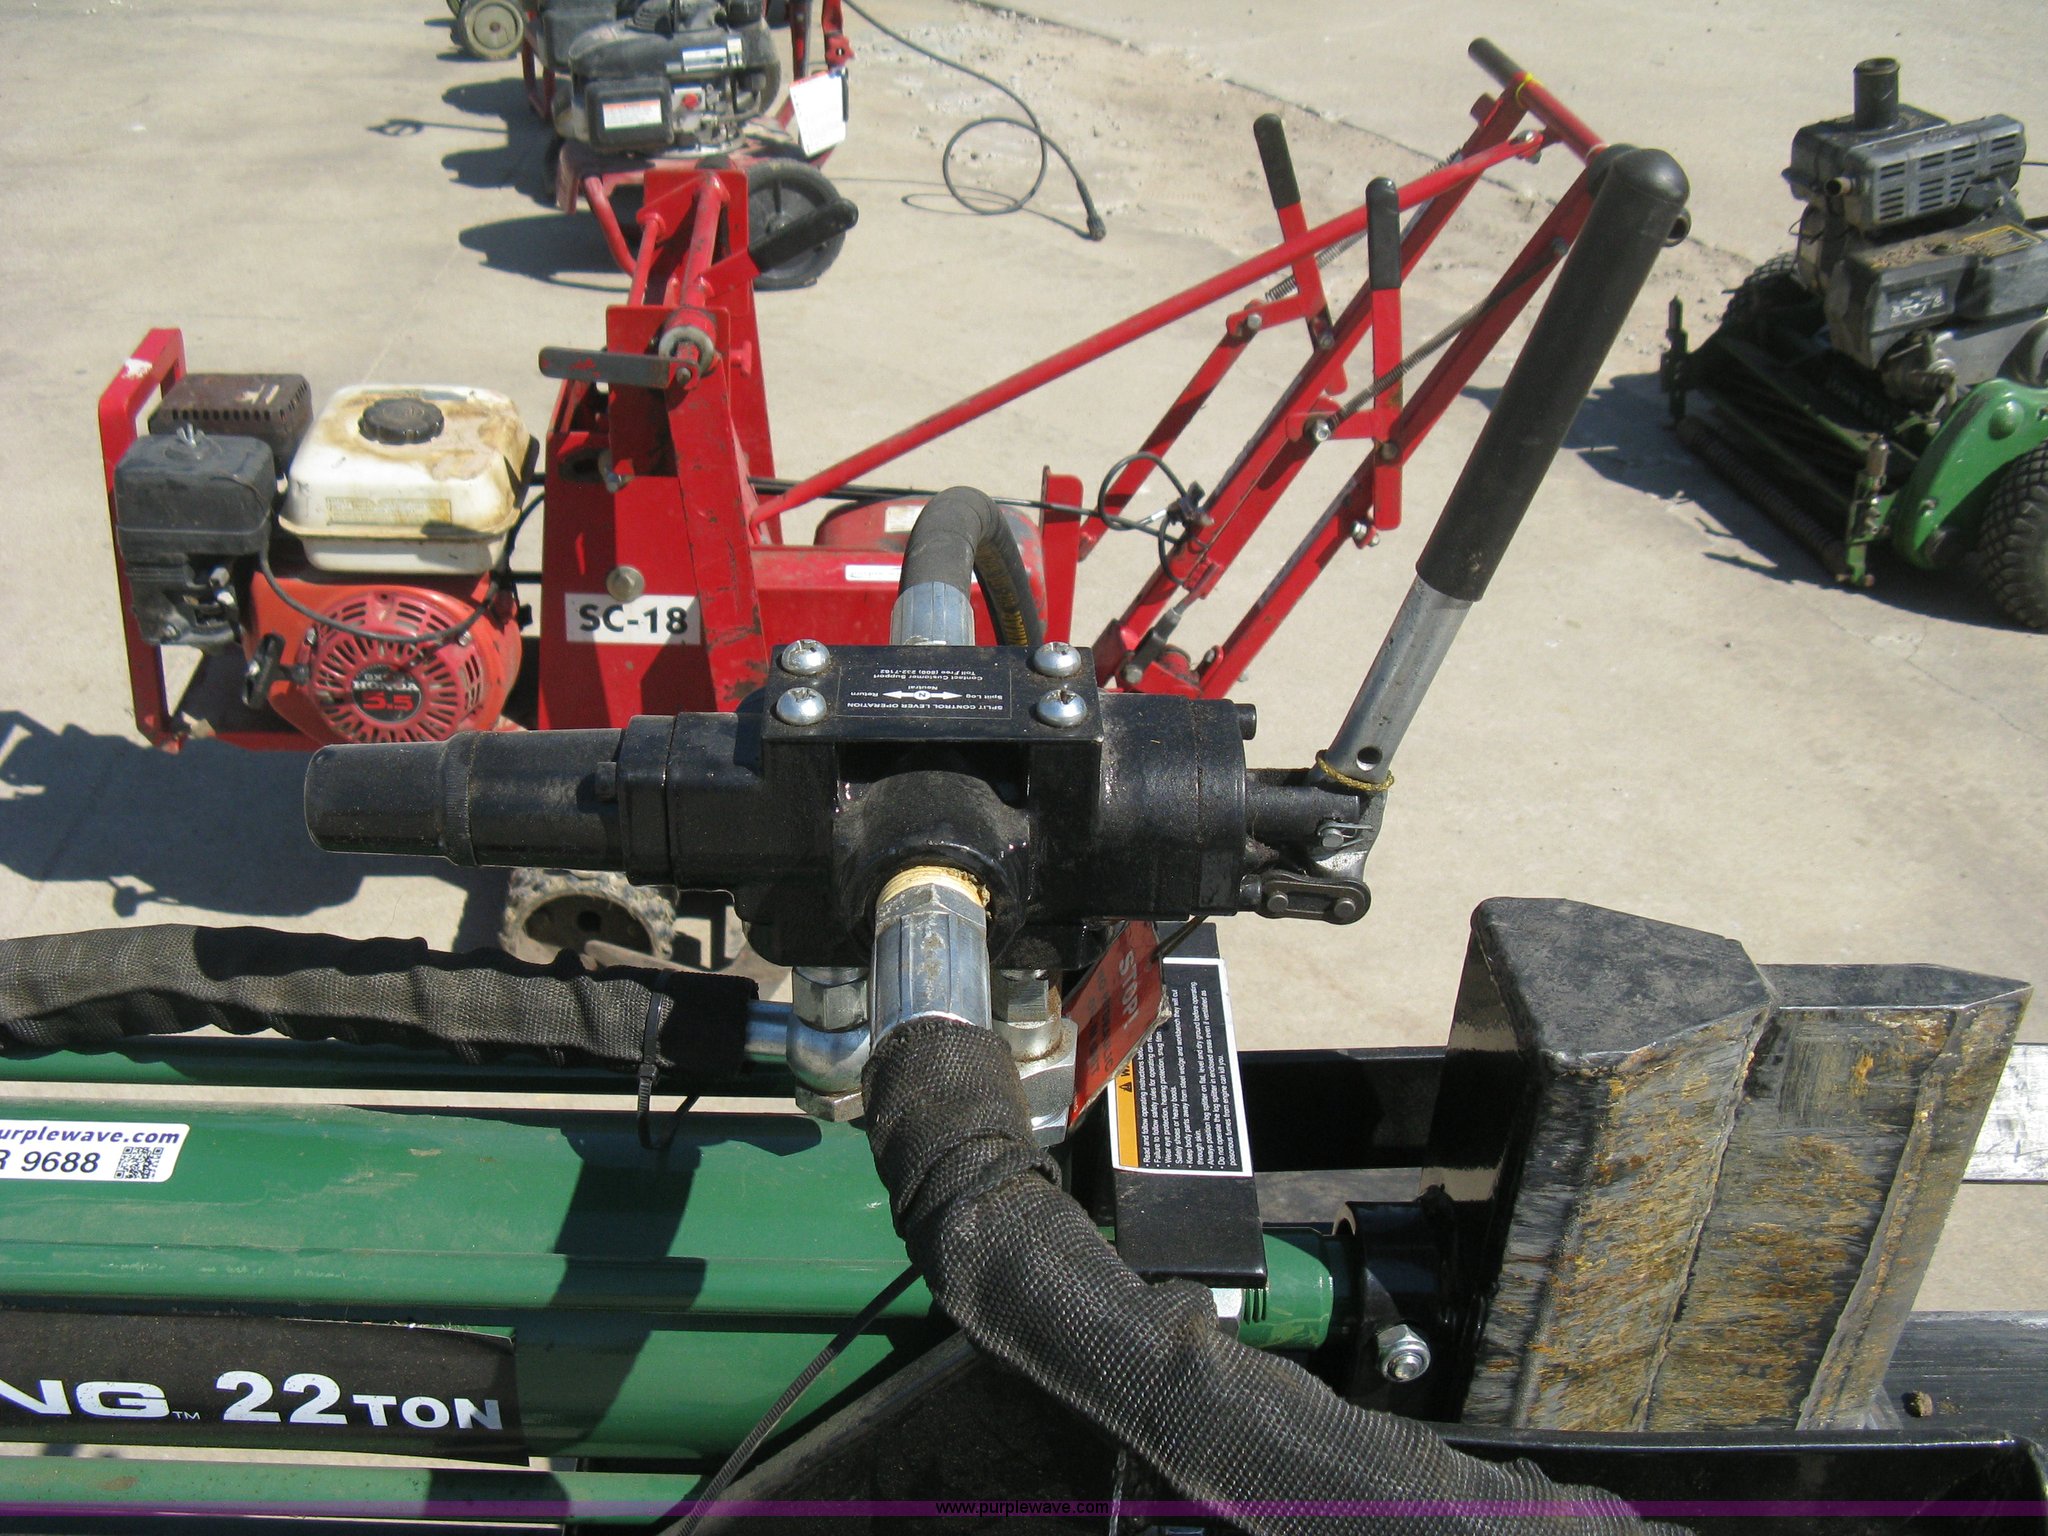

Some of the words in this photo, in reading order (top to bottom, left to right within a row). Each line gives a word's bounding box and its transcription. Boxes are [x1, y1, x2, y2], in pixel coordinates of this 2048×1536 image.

[579, 603, 689, 635] SC-18
[353, 681, 420, 691] HONDA
[362, 691, 414, 711] 5.5
[1119, 950, 1138, 1030] STOP!
[1173, 1007, 1181, 1017] they
[1192, 1006, 1200, 1021] before
[1201, 997, 1209, 1020] ventilated
[1174, 1018, 1182, 1045] workbench
[1194, 1022, 1203, 1040] ground
[1196, 1041, 1204, 1049] dry
[1196, 1050, 1204, 1060] and
[1148, 1054, 1156, 1078] operating
[1178, 1057, 1186, 1074] wedge
[1207, 1055, 1216, 1078] enclosed
[1138, 1061, 1146, 1090] instructions
[1160, 1085, 1168, 1105] hearing
[1201, 1093, 1210, 1111] splitter
[1211, 1085, 1219, 1102] splitter
[1221, 1086, 1230, 1103] engine
[1140, 1092, 1148, 1117] operating
[1151, 1102, 1159, 1118] safety
[1183, 1119, 1191, 1132] parts
[1203, 1112, 1211, 1121] log
[1164, 1136, 1172, 1147] eye
[1174, 1128, 1182, 1144] shoes
[1184, 1134, 1192, 1147] body
[1205, 1122, 1213, 1143] position
[1215, 1124, 1224, 1145] operate
[1153, 1144, 1161, 1163] Failure
[1164, 1148, 1172, 1163] Wear
[1175, 1146, 1183, 1164] Safety
[1186, 1149, 1194, 1164] Keep
[1196, 1143, 1204, 1165] through
[1207, 1145, 1215, 1165] Always
[1218, 1156, 1225, 1165] Do
[1227, 1137, 1237, 1166] poisonous
[20, 1150, 101, 1173] 9688
[215, 1369, 348, 1425] 22
[352, 1393, 503, 1431] TON
